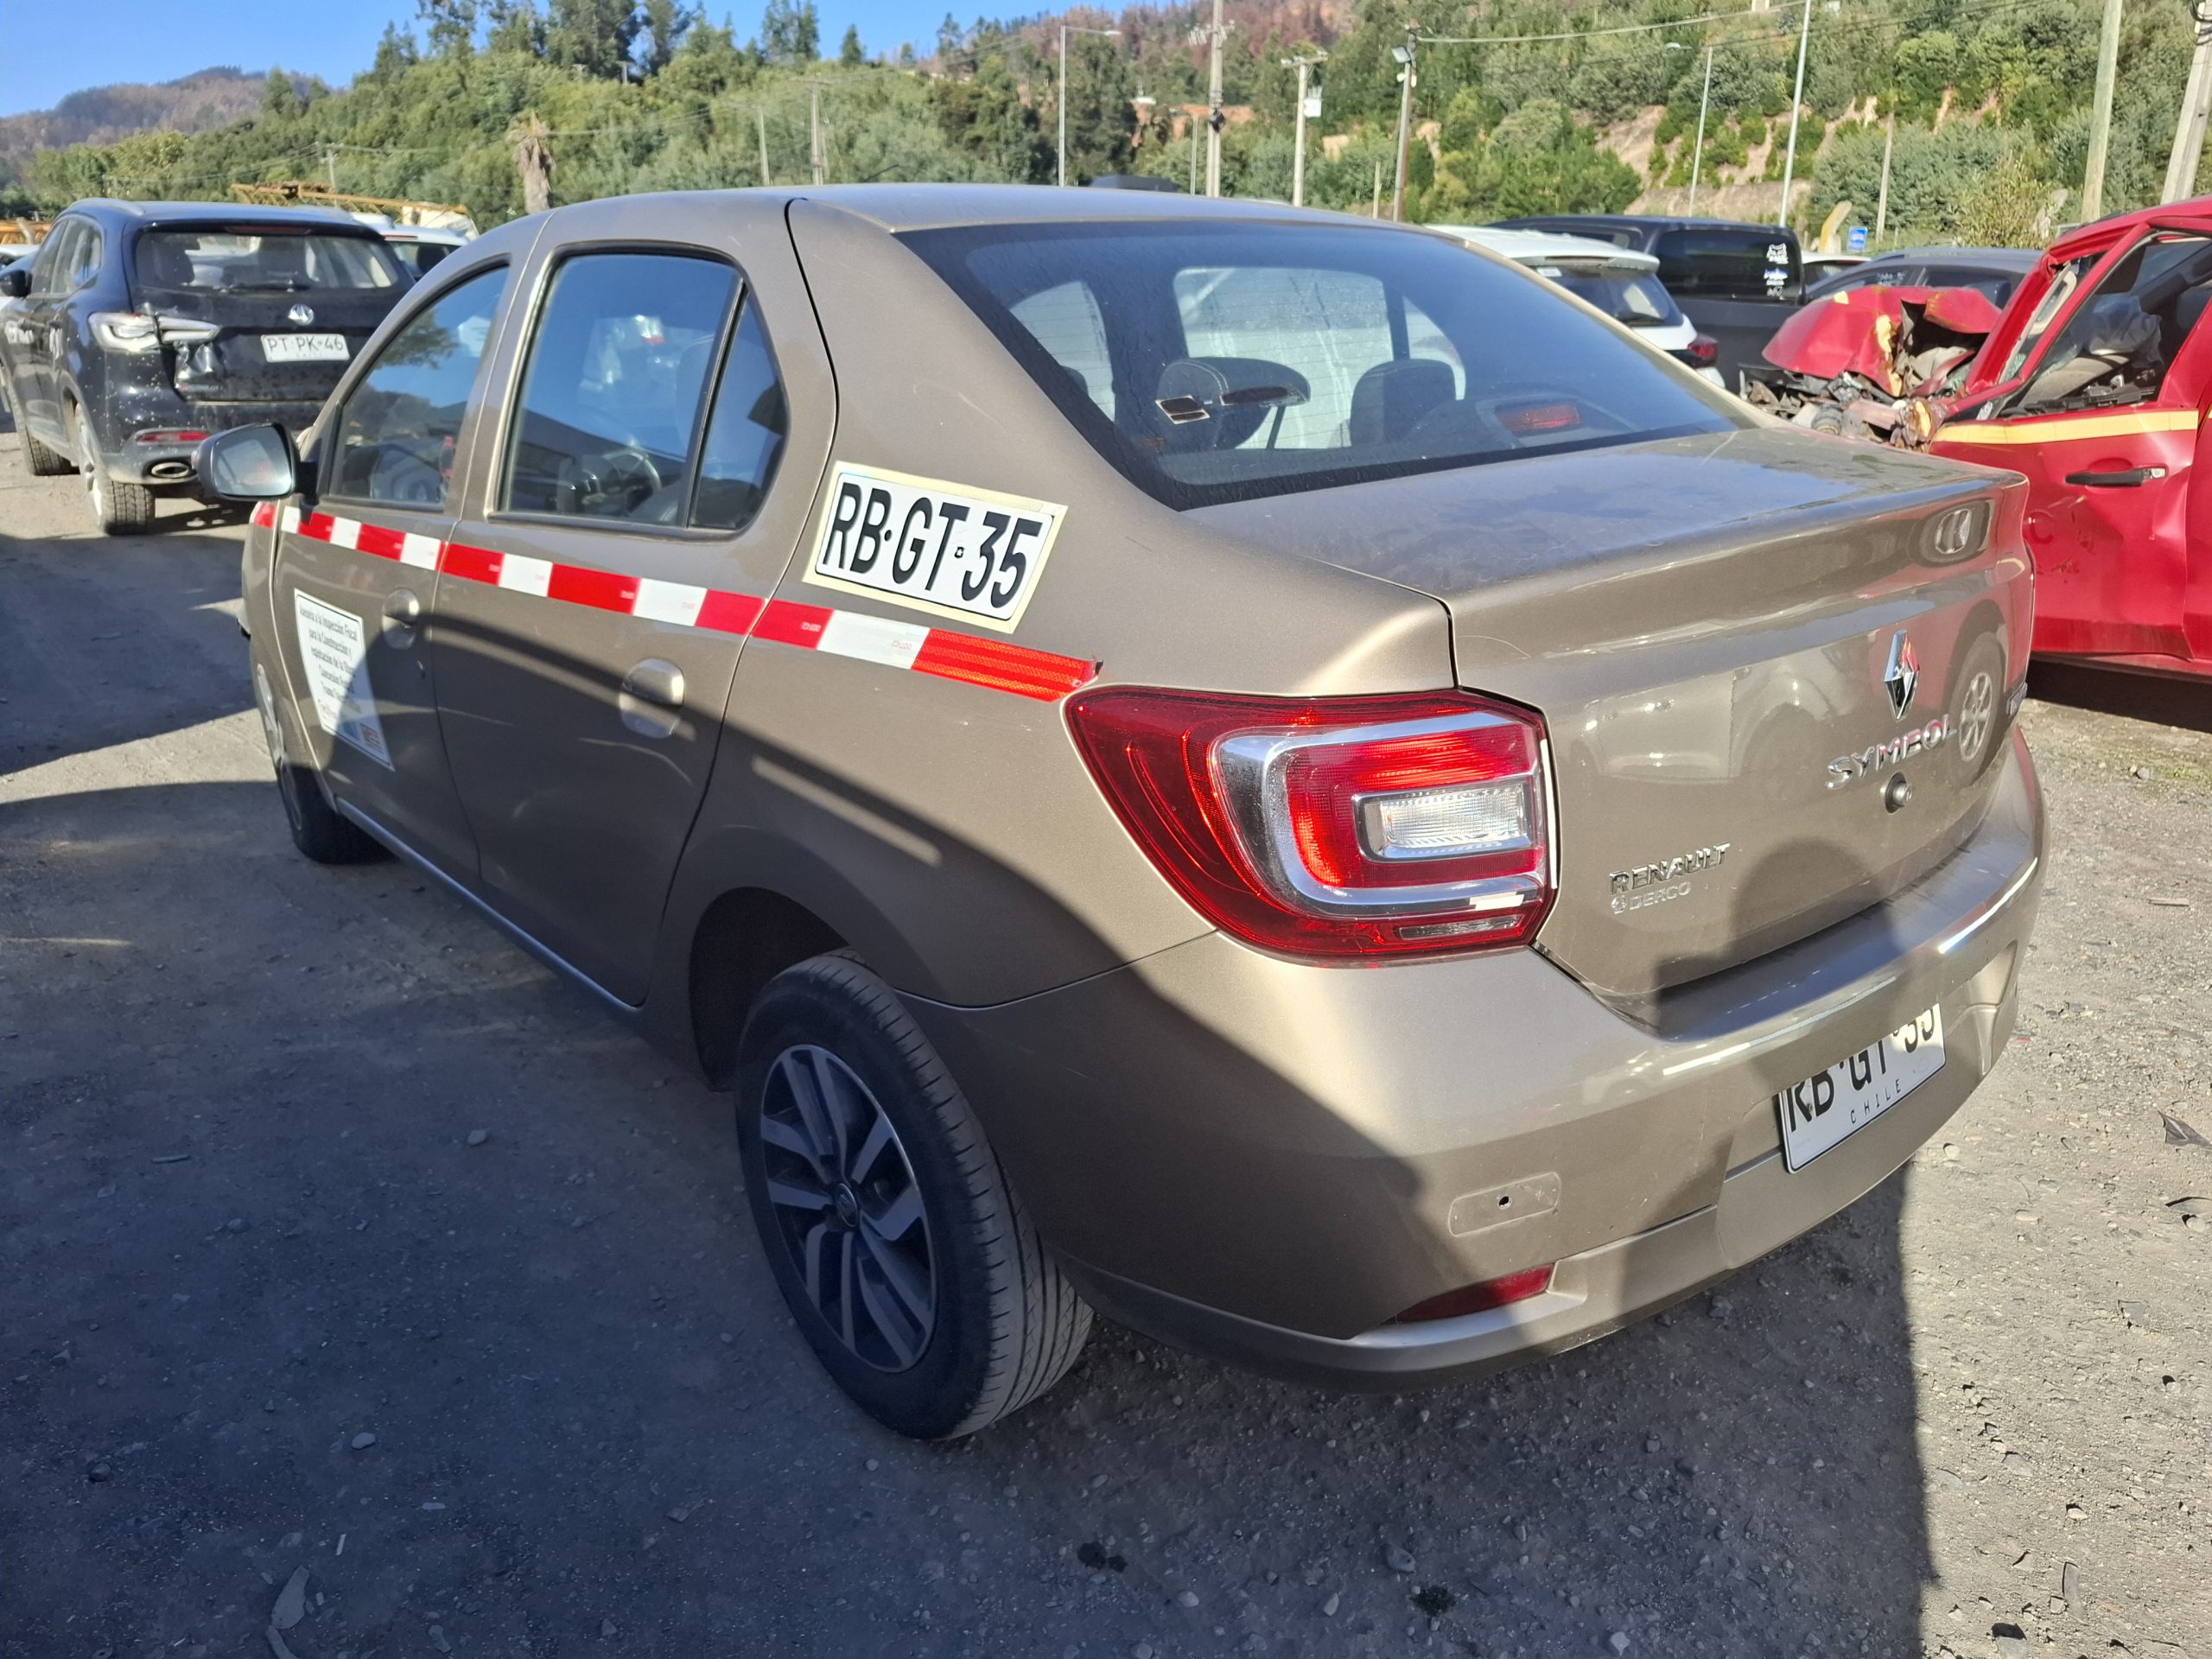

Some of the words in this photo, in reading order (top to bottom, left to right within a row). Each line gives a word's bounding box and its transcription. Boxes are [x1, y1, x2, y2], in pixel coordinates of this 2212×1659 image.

[1825, 713, 1957, 788] SYMBOL
[1609, 843, 1731, 893] RENAULT
[1630, 881, 1691, 911] DERCO
[1851, 1078, 1902, 1124] CHILE
